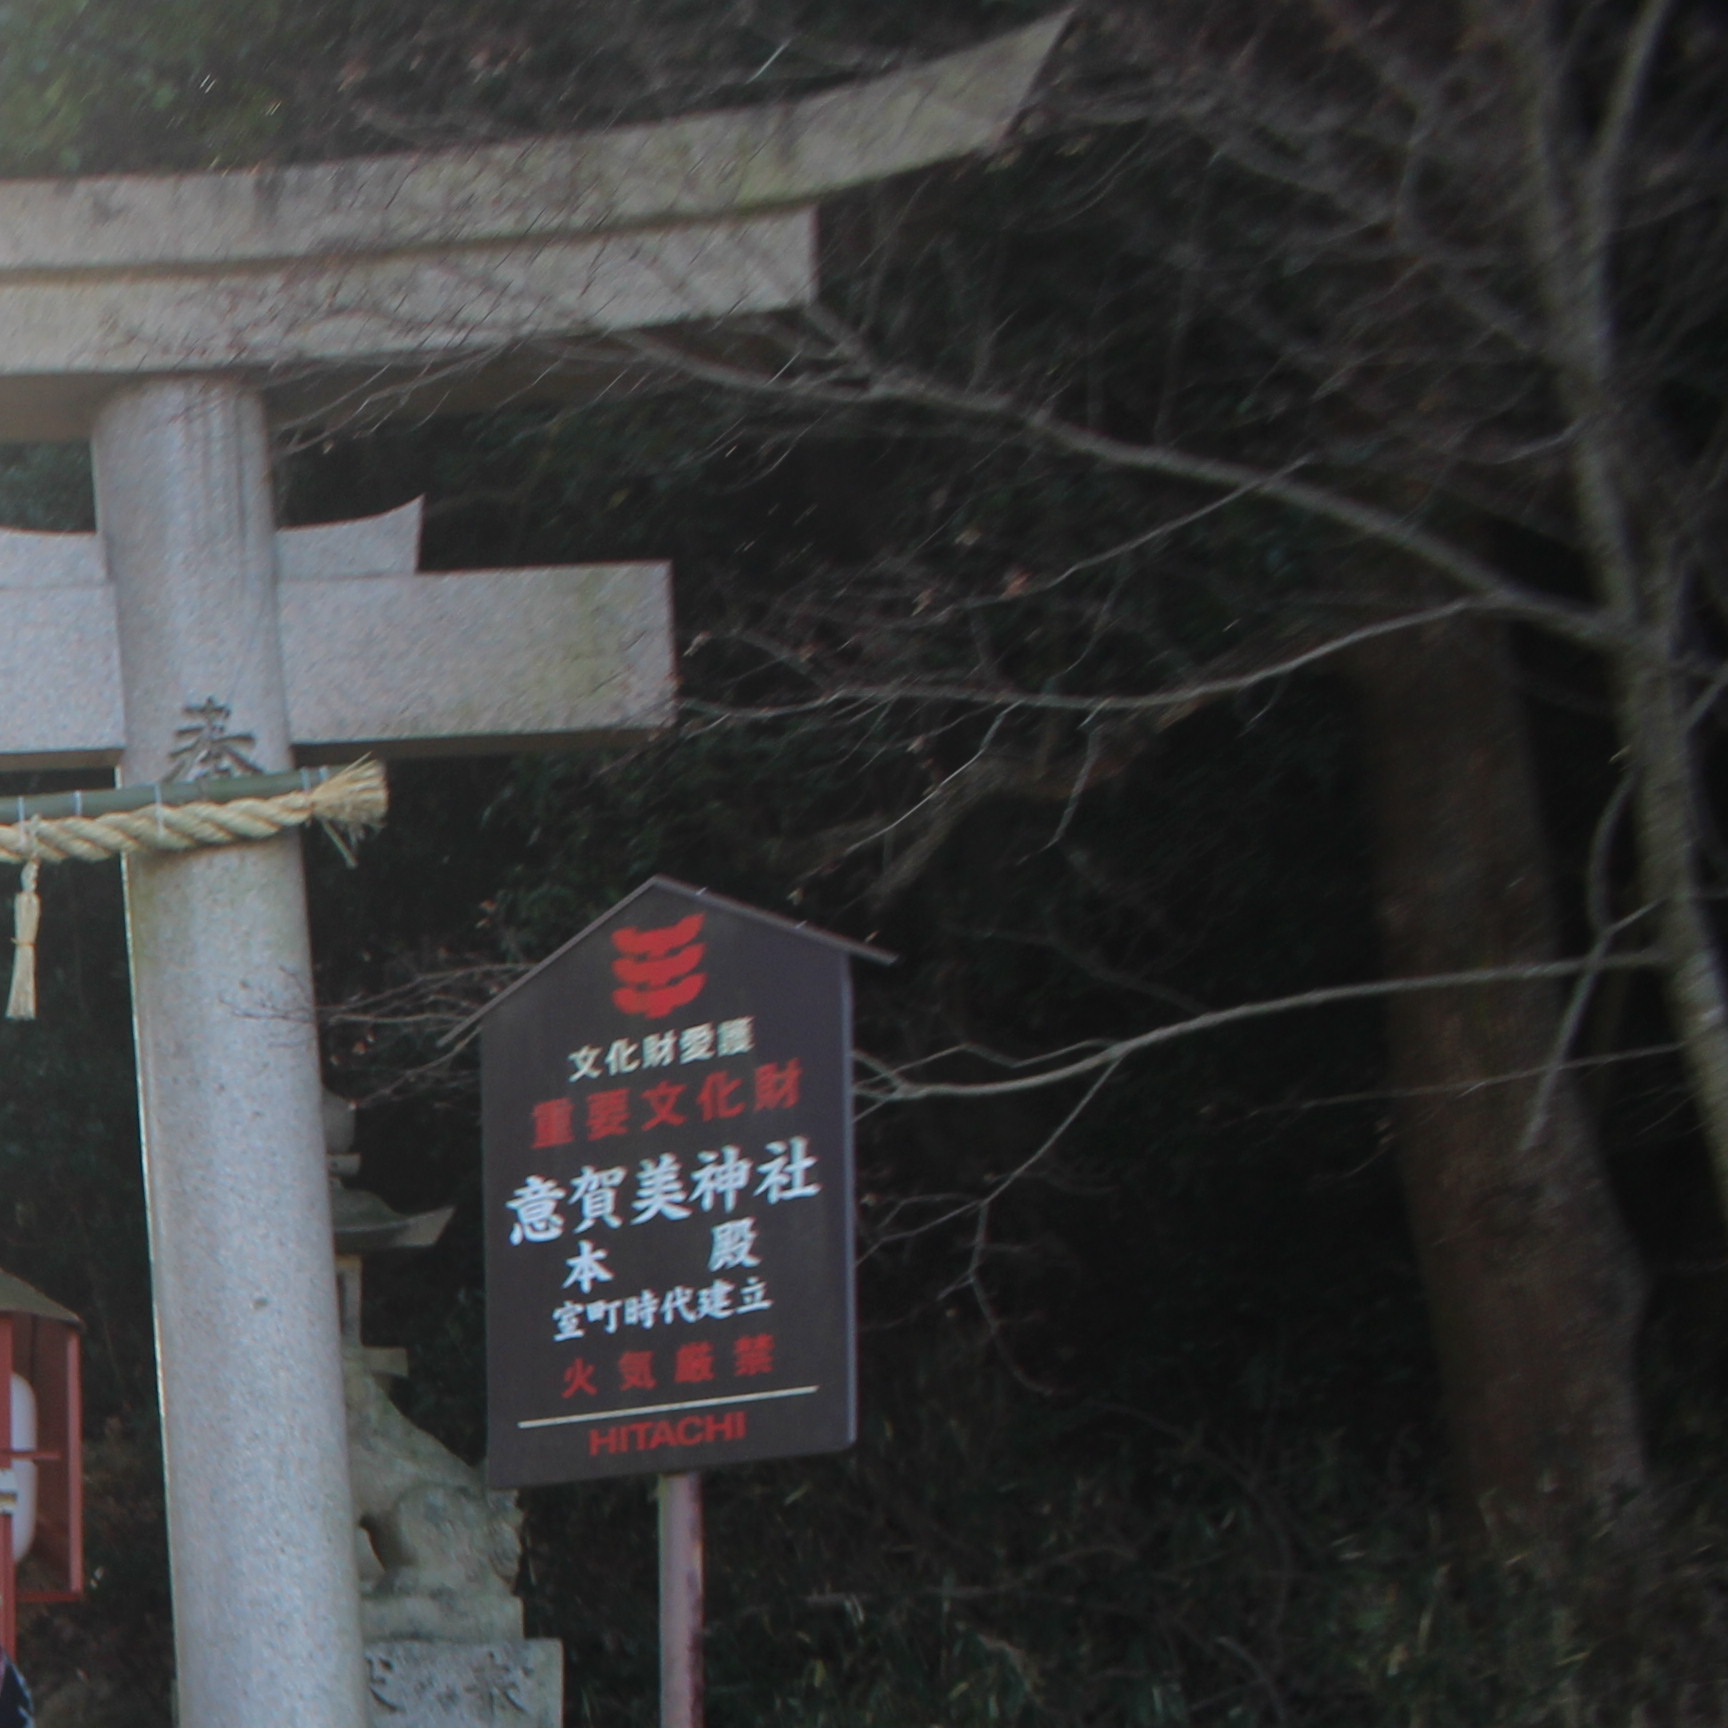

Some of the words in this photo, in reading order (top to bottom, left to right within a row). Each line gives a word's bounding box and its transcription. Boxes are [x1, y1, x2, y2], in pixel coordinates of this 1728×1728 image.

[568, 1016, 755, 1082] 文化財愛護
[530, 1058, 804, 1150] 重要文化財
[505, 1134, 824, 1247] 意賀美神社
[552, 1277, 774, 1342] 室町時代建立
[561, 1333, 776, 1399] 火気厳禁
[588, 1410, 747, 1457] HITACHI
